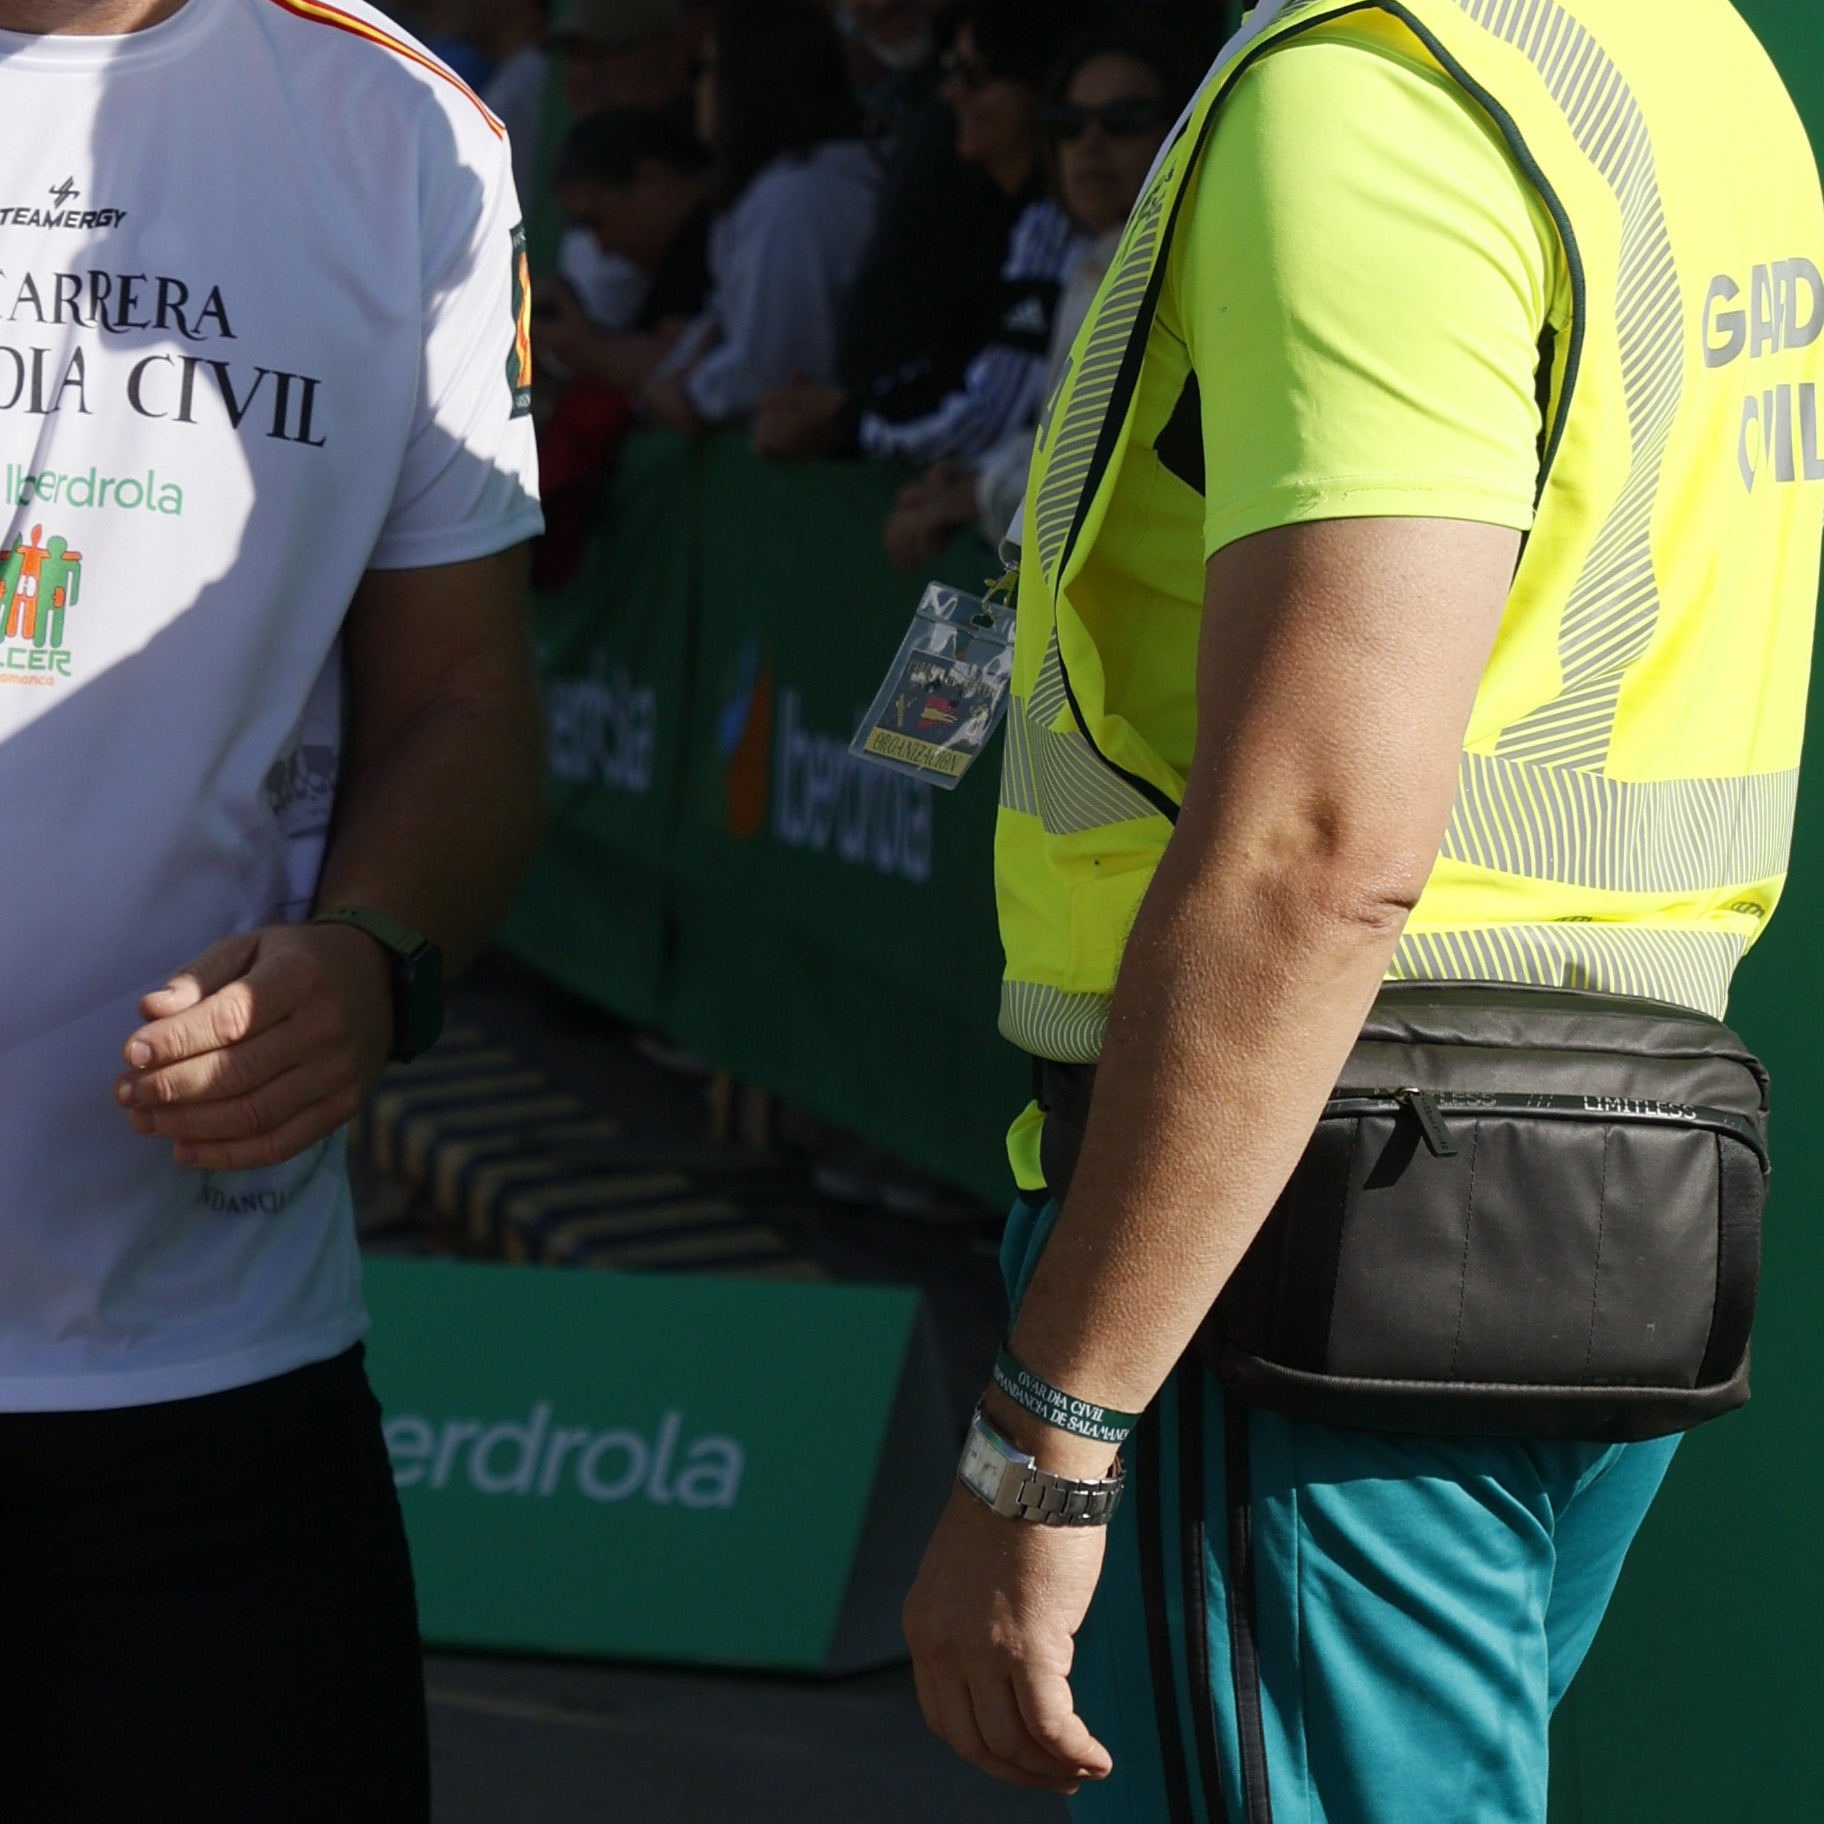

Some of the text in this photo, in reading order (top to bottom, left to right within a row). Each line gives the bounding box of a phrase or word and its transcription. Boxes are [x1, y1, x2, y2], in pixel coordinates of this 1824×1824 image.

[126, 353, 328, 448] CIVIL
[5, 462, 185, 516] Iberdrola
[1583, 1095, 1698, 1120] LIMITLESS
[1049, 1409, 1068, 1427] DE
[382, 1398, 747, 1511] erdrola
